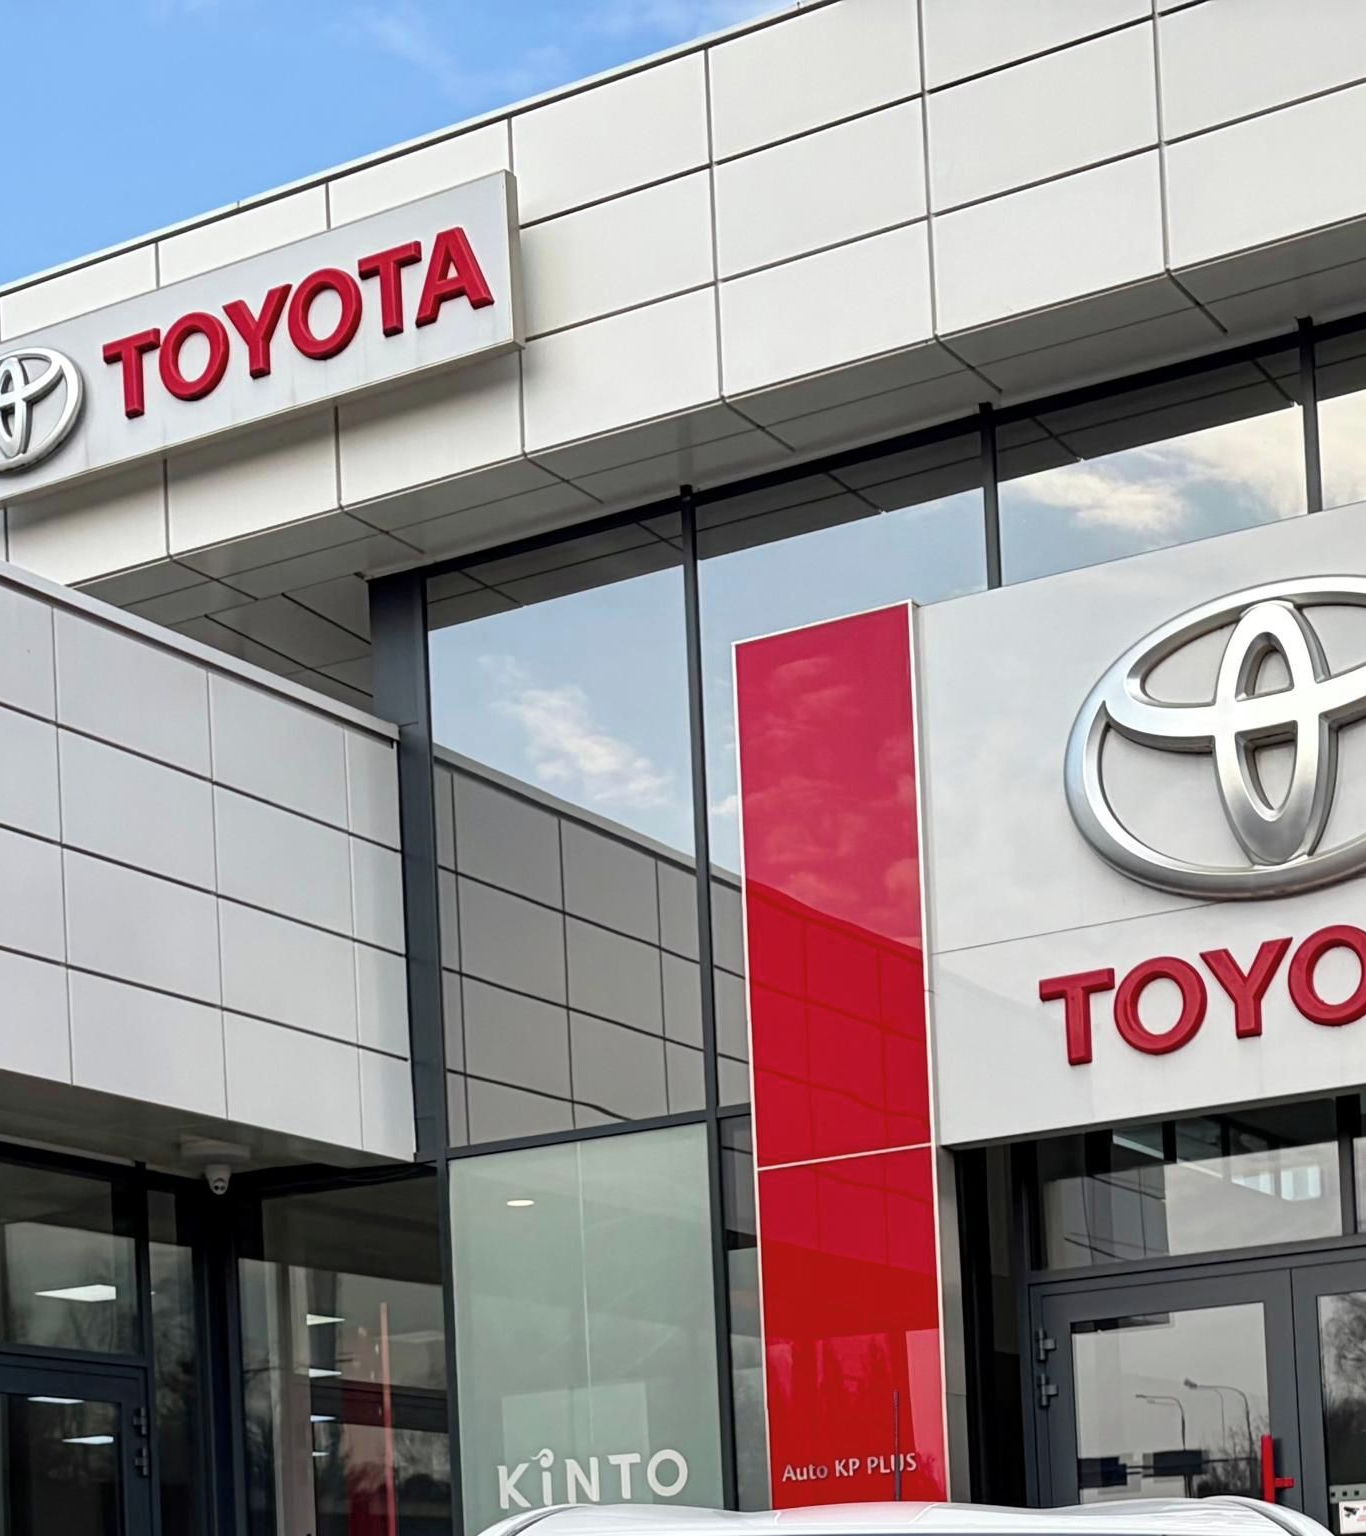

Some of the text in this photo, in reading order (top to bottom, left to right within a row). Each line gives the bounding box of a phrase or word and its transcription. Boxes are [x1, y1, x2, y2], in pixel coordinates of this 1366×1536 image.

[102, 226, 494, 419] TOYOTA
[782, 1452, 917, 1482] Auto KP PLUS
